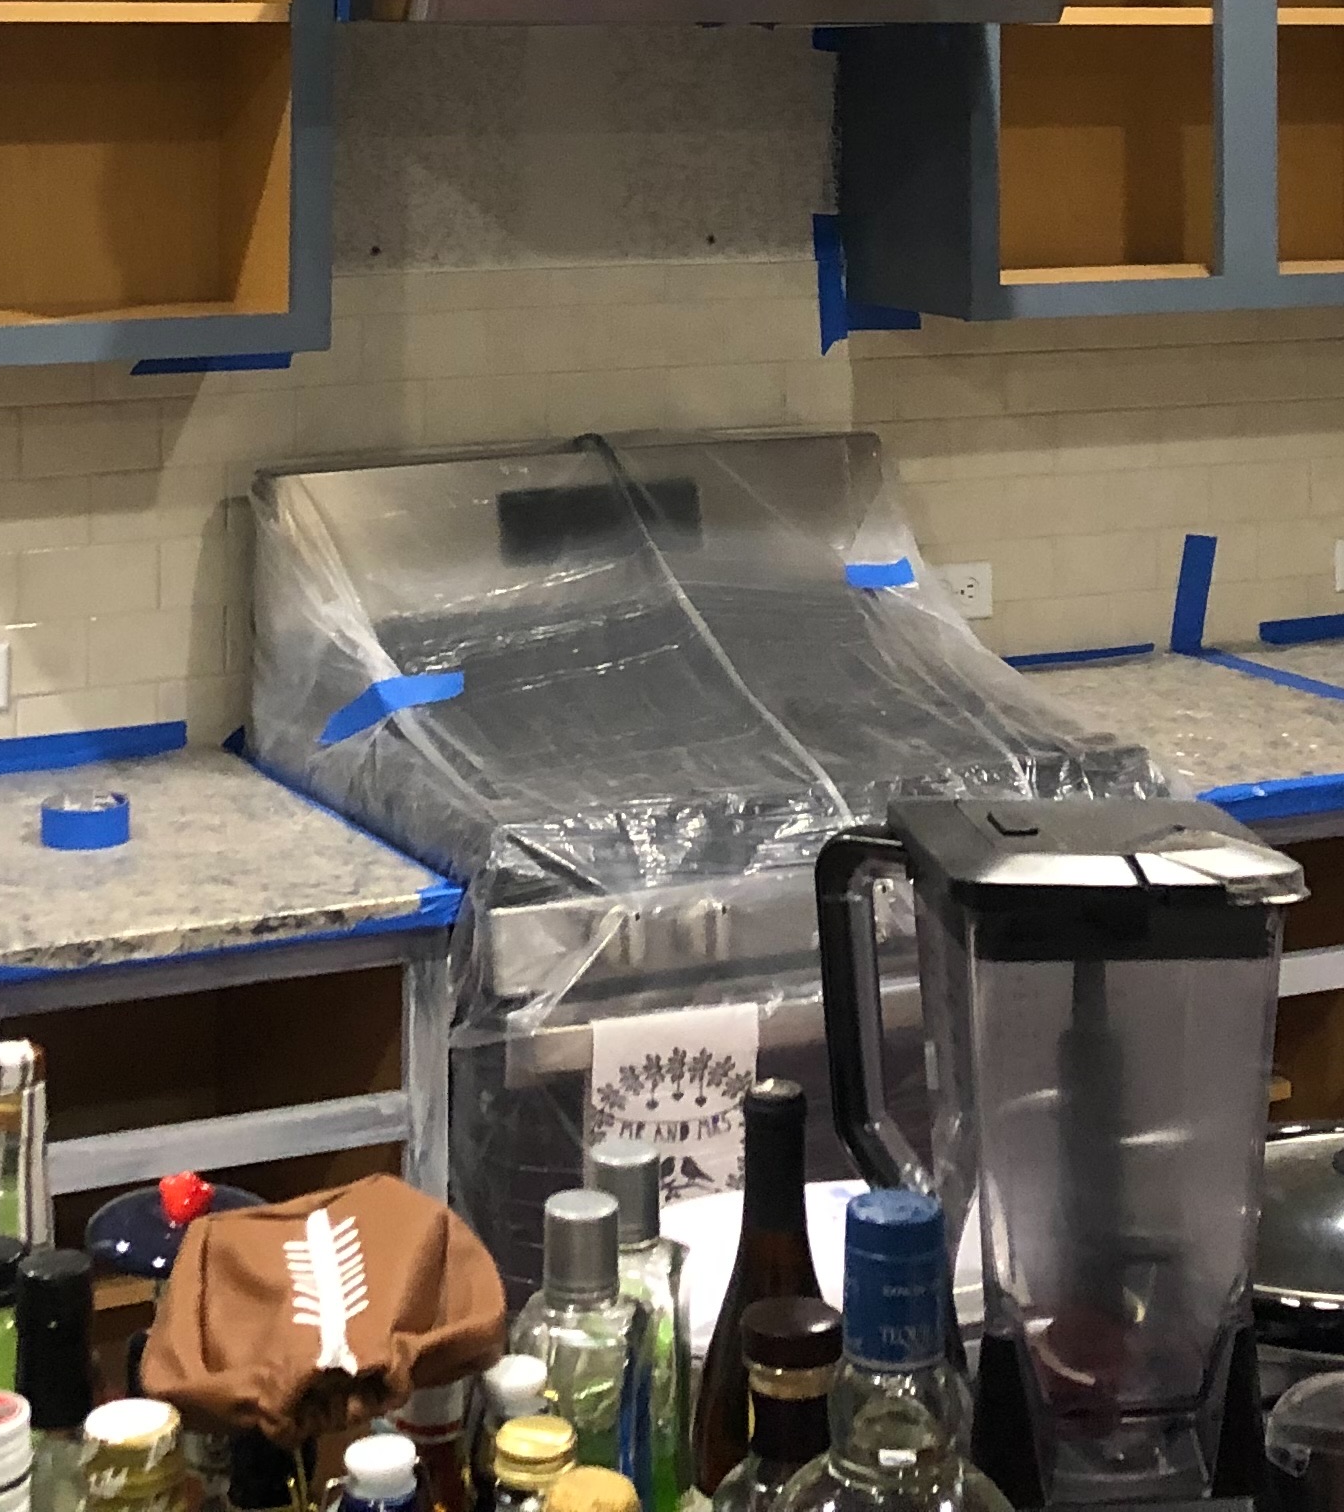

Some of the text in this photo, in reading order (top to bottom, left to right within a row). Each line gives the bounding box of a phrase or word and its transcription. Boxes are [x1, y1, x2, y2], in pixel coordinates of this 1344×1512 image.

[620, 1113, 732, 1143] MR AND MRS
